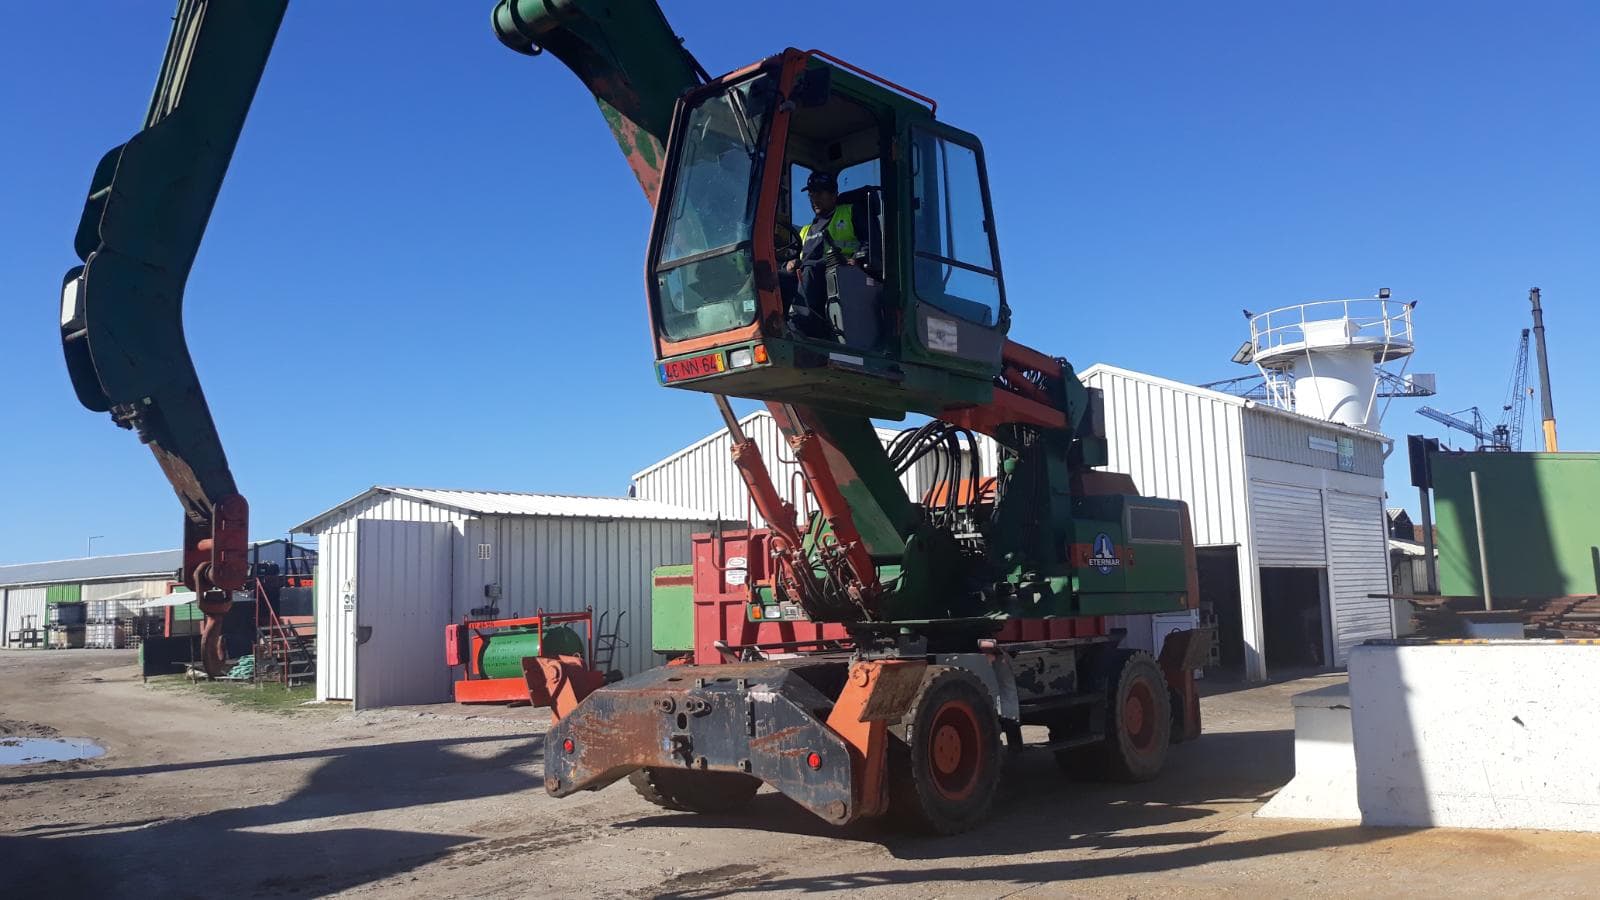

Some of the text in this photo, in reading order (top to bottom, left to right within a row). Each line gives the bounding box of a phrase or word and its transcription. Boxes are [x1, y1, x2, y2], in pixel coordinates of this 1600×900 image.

[681, 359, 700, 376] NN
[702, 354, 717, 372] 64
[1088, 558, 1120, 566] ETERMAR
